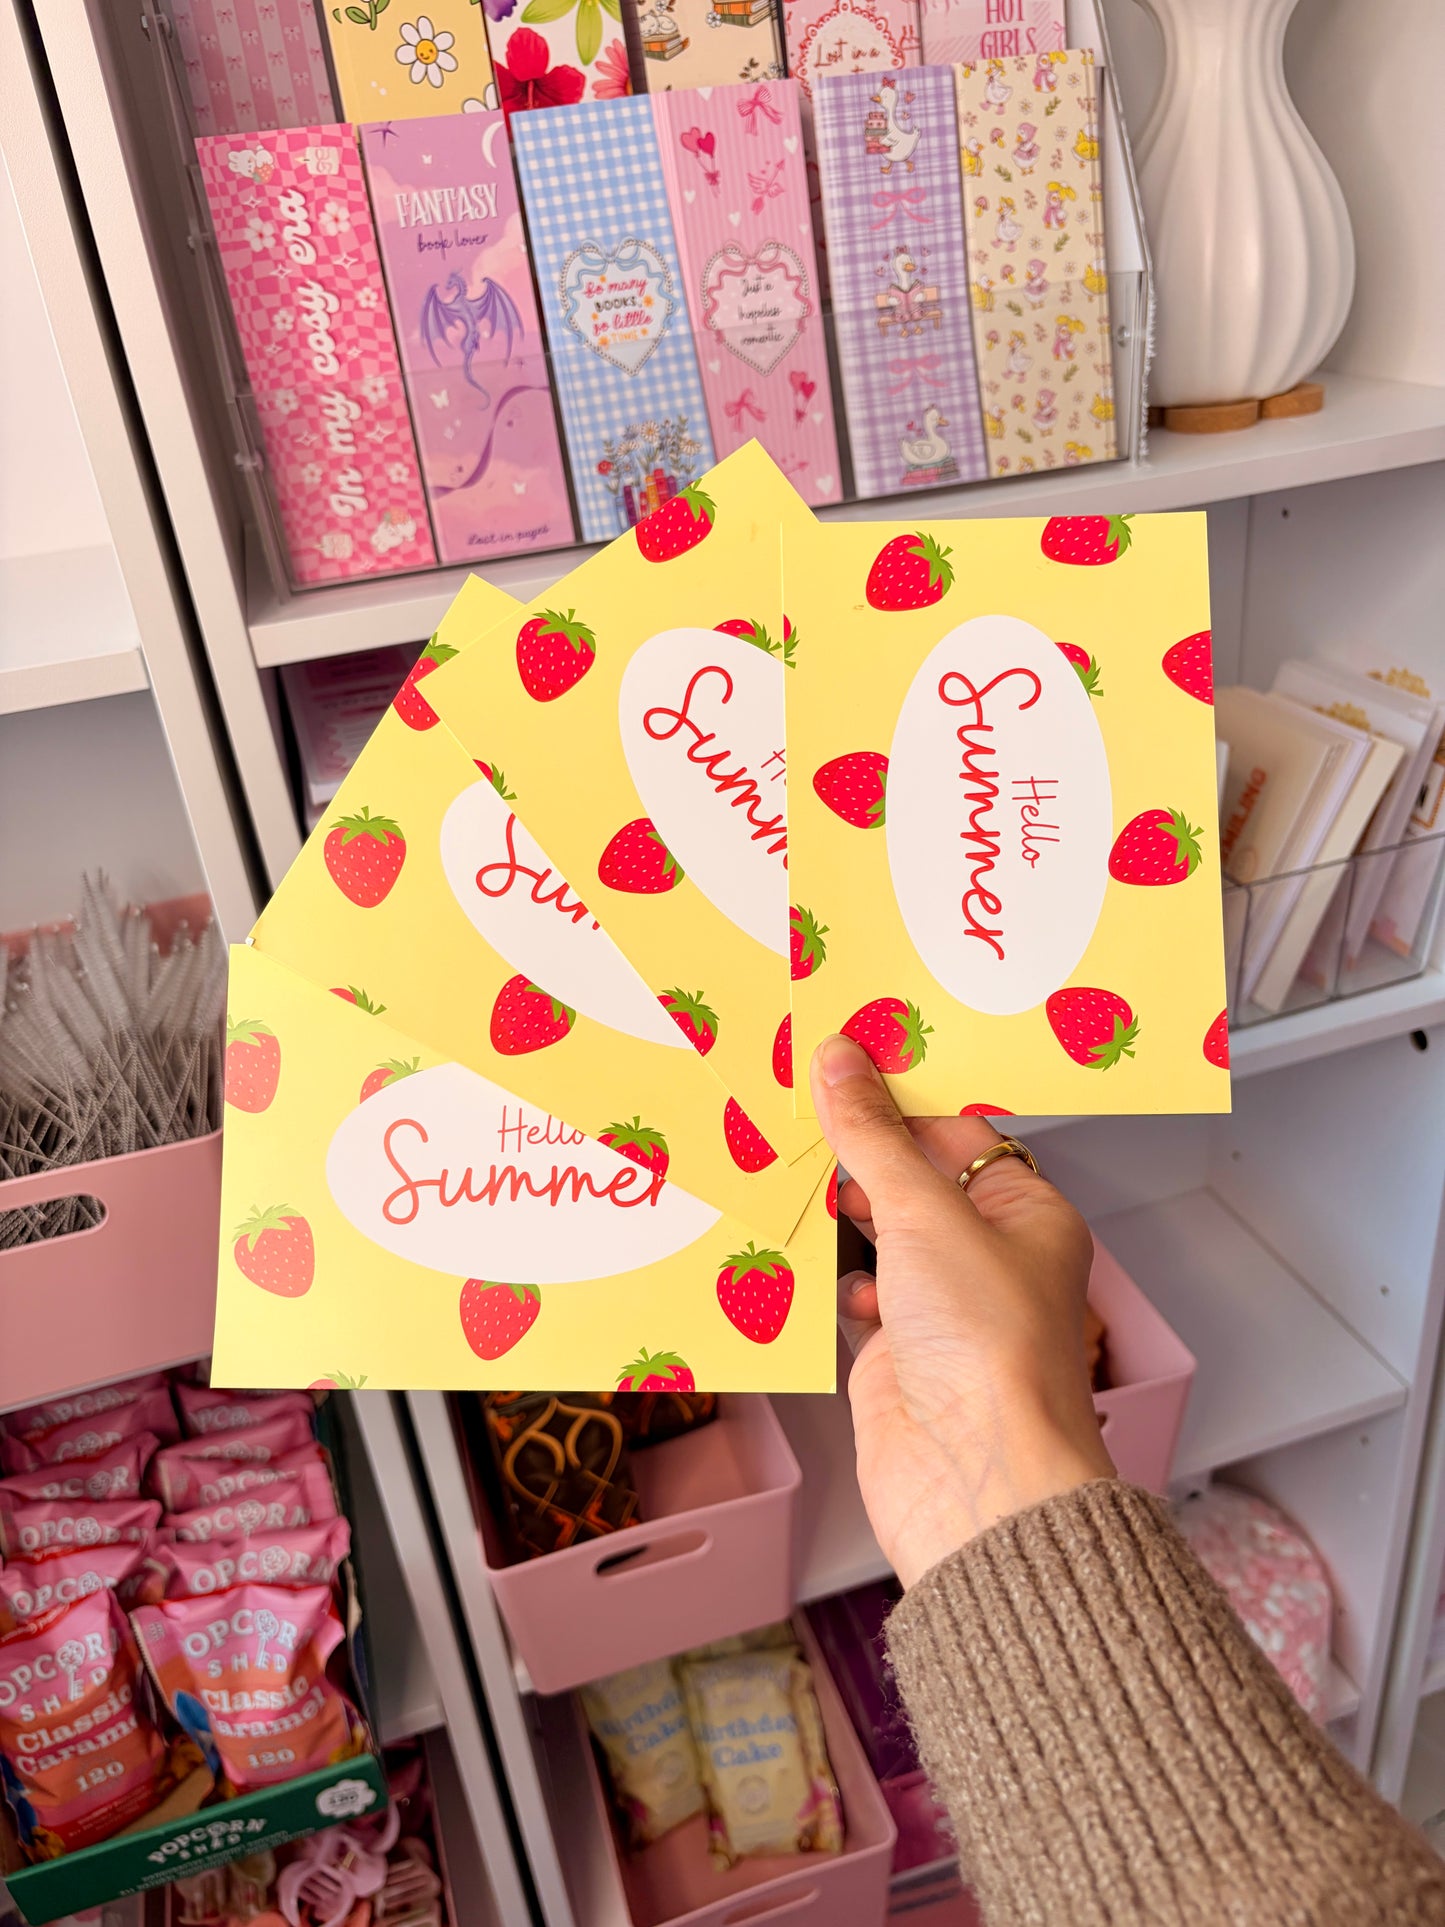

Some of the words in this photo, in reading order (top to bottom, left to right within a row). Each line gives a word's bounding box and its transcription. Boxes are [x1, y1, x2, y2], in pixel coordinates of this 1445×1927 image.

[813, 37, 848, 68] Lost
[851, 46, 867, 60] in
[868, 47, 881, 58] a
[980, 27, 1037, 60] GIRLS
[395, 183, 498, 229] FANTASY
[277, 188, 317, 266] era
[416, 230, 453, 261] book
[454, 229, 488, 248] lover
[607, 279, 648, 297] many
[742, 274, 765, 298] Just
[765, 283, 774, 291] a
[297, 278, 341, 376] cosy
[613, 310, 653, 330] little
[738, 302, 782, 325] hopeless
[740, 322, 784, 345] romantic
[319, 390, 362, 455] my
[329, 466, 369, 518] In
[938, 667, 1042, 961] Summer
[1012, 776, 1060, 869] Hello
[207, 1651, 288, 1679] SHED
[19, 1667, 108, 1723] SHED
[201, 1675, 310, 1714] Classic
[209, 1686, 327, 1738] aramel
[16, 1684, 133, 1754] Classic
[248, 1748, 296, 1769] 120
[76, 1761, 125, 1793] 120
[148, 1818, 268, 1864] POPCORN
[178, 1833, 242, 1860] SHED
